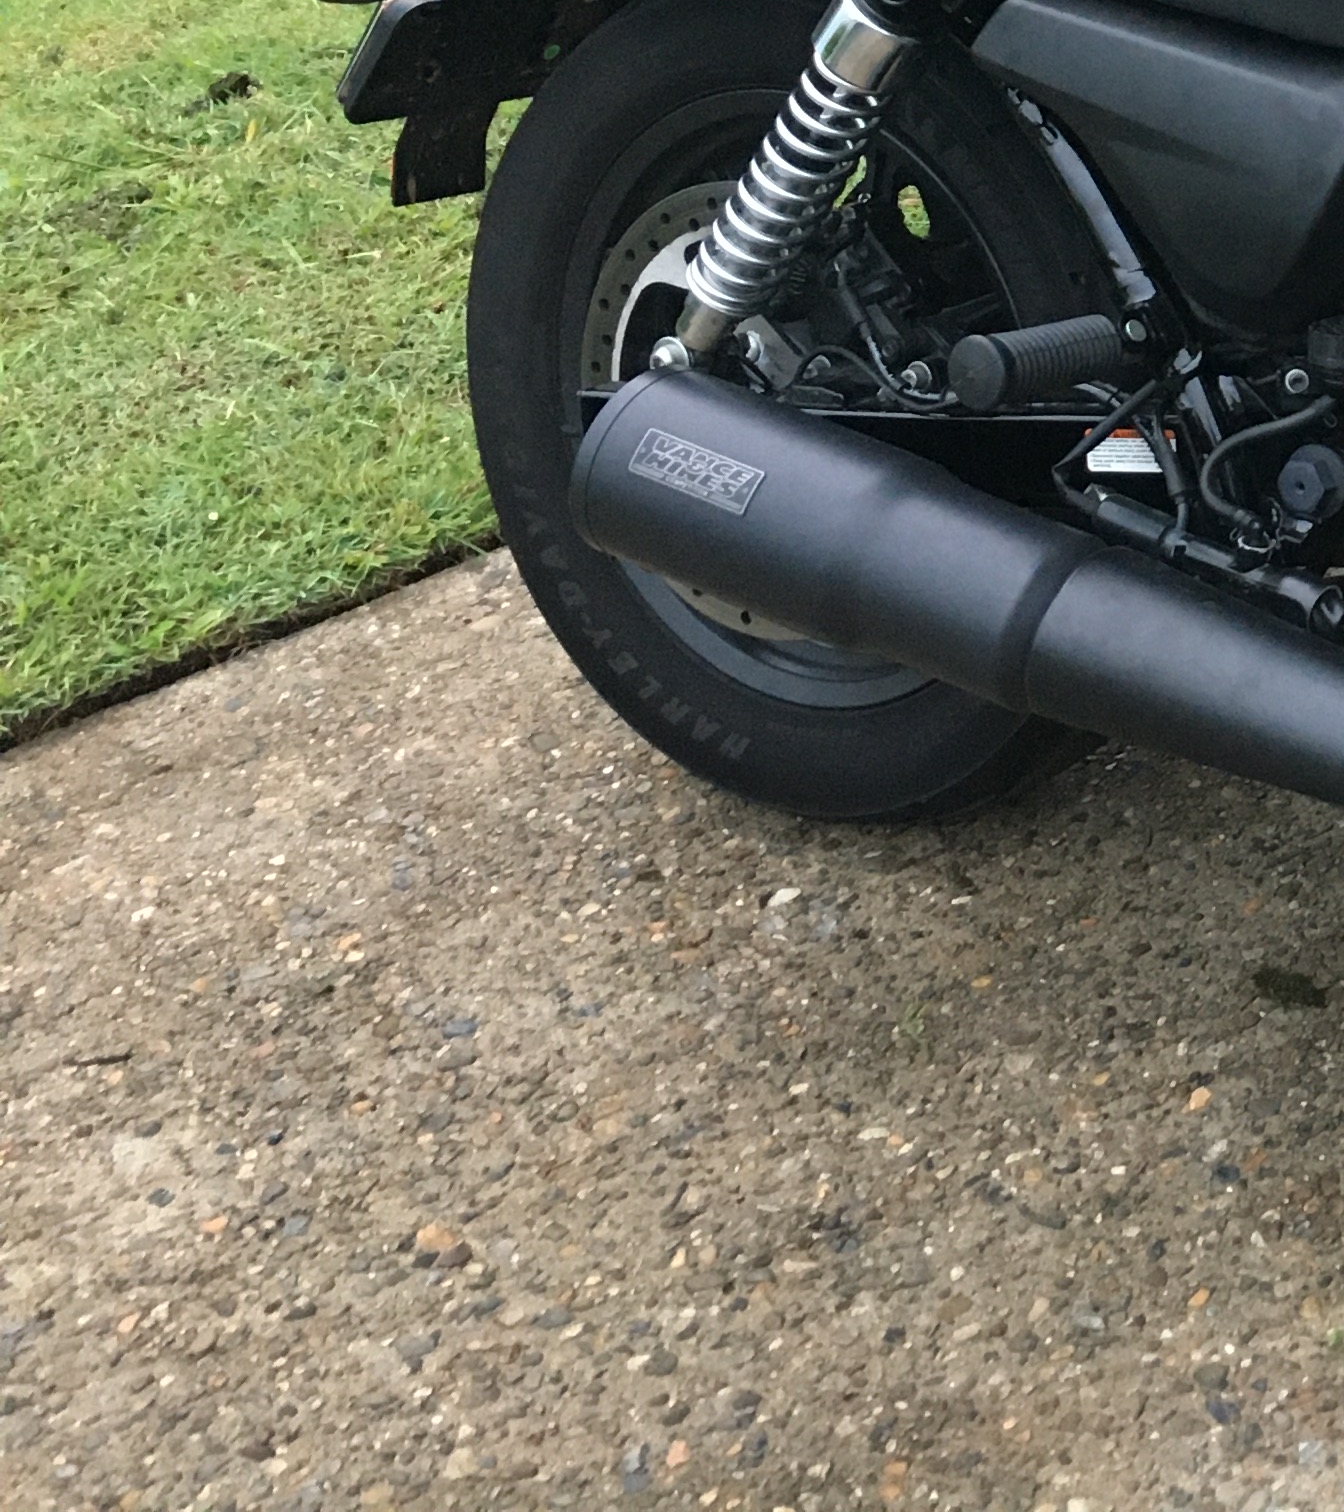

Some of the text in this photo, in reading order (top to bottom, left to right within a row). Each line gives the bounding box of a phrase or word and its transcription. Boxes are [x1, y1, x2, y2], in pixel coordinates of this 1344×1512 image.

[641, 451, 739, 499] HINES
[652, 435, 756, 487] VANCE
[498, 441, 752, 761] HARLEY-DAVID
